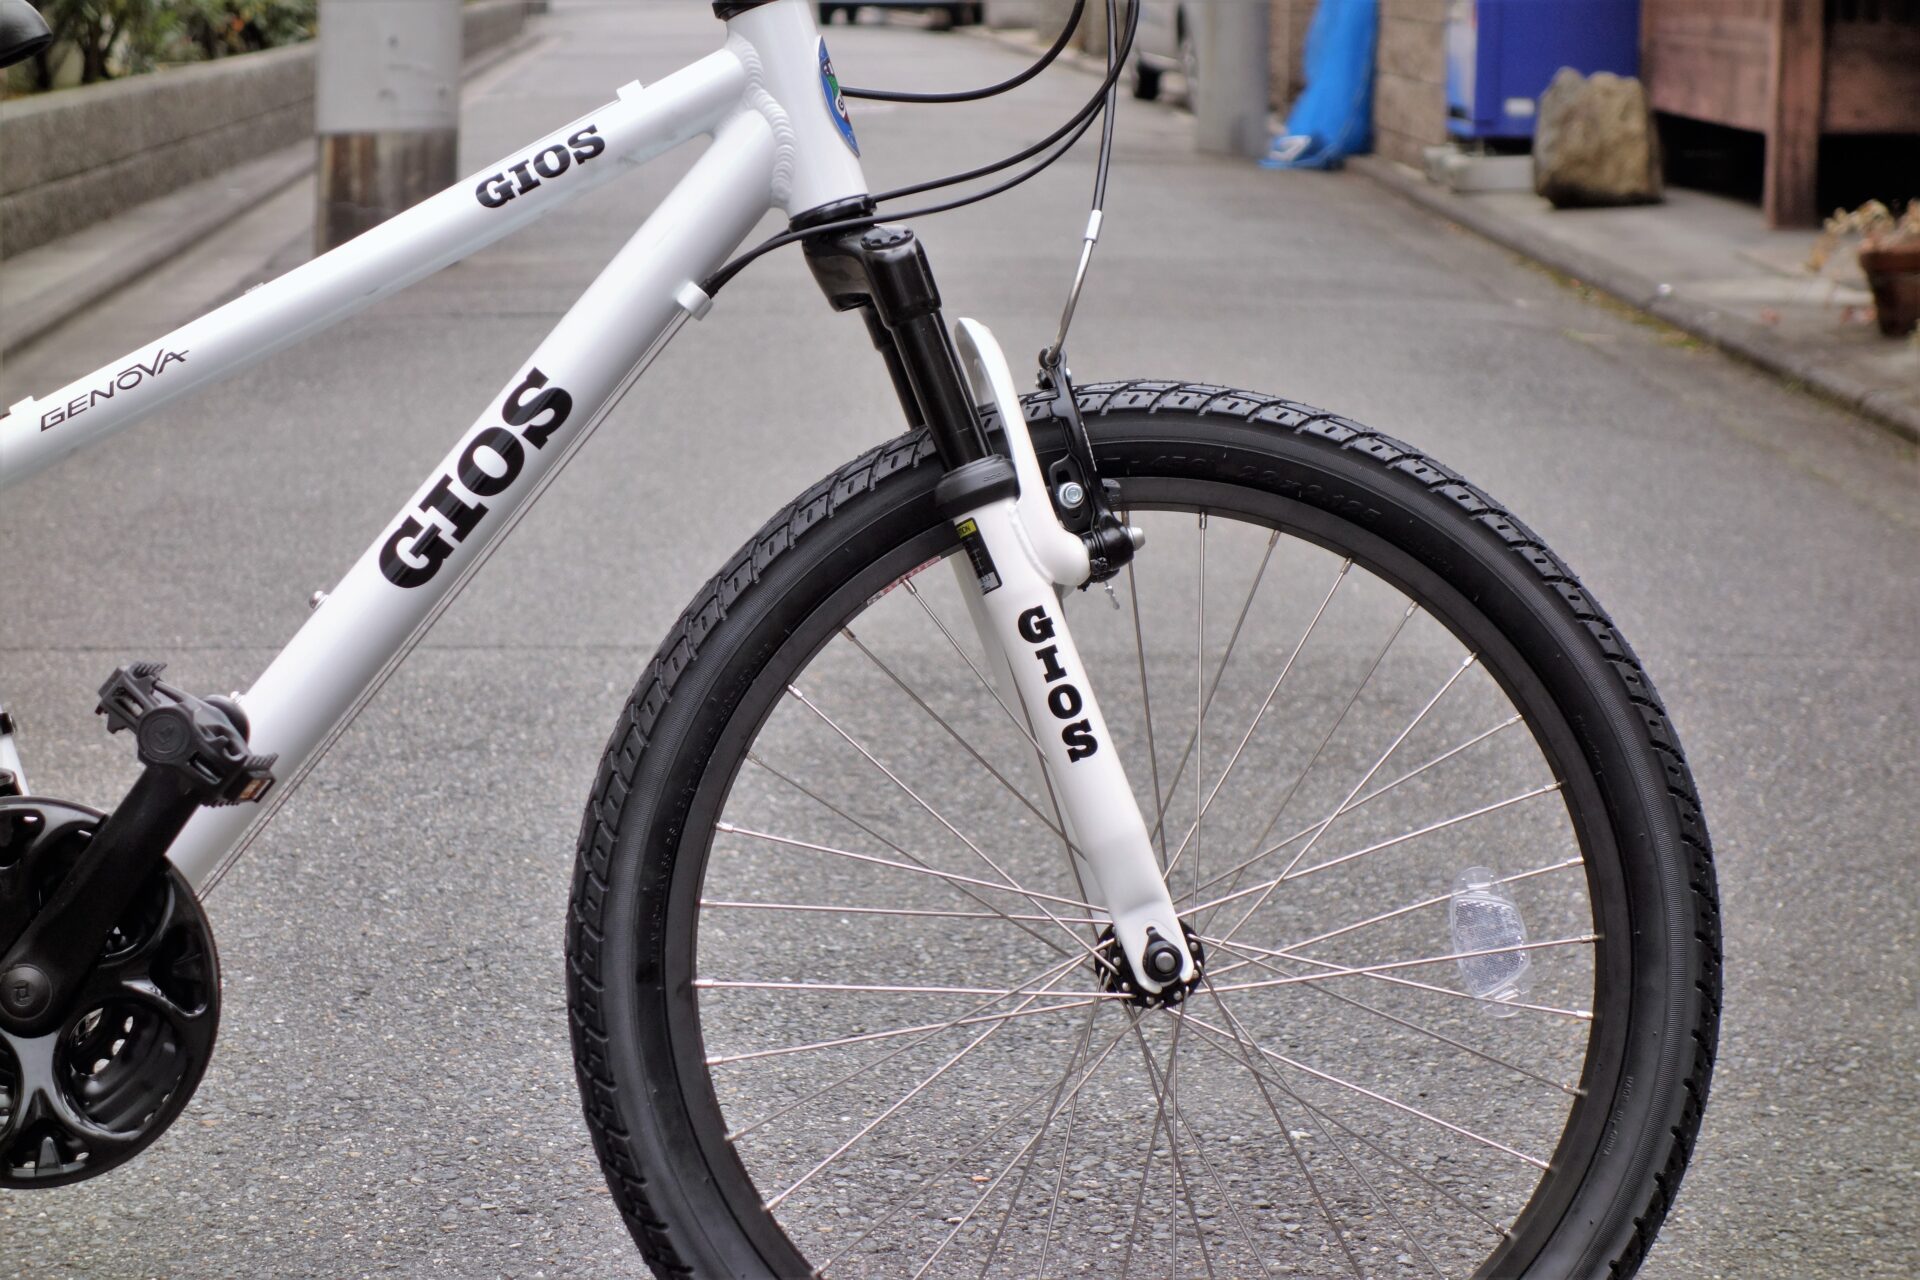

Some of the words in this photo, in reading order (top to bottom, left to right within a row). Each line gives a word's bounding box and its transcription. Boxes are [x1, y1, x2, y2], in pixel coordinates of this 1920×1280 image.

[475, 124, 606, 208] GIOS
[40, 348, 190, 432] GENOVA
[379, 366, 573, 588] GIOS
[1018, 605, 1099, 763] GIOS
